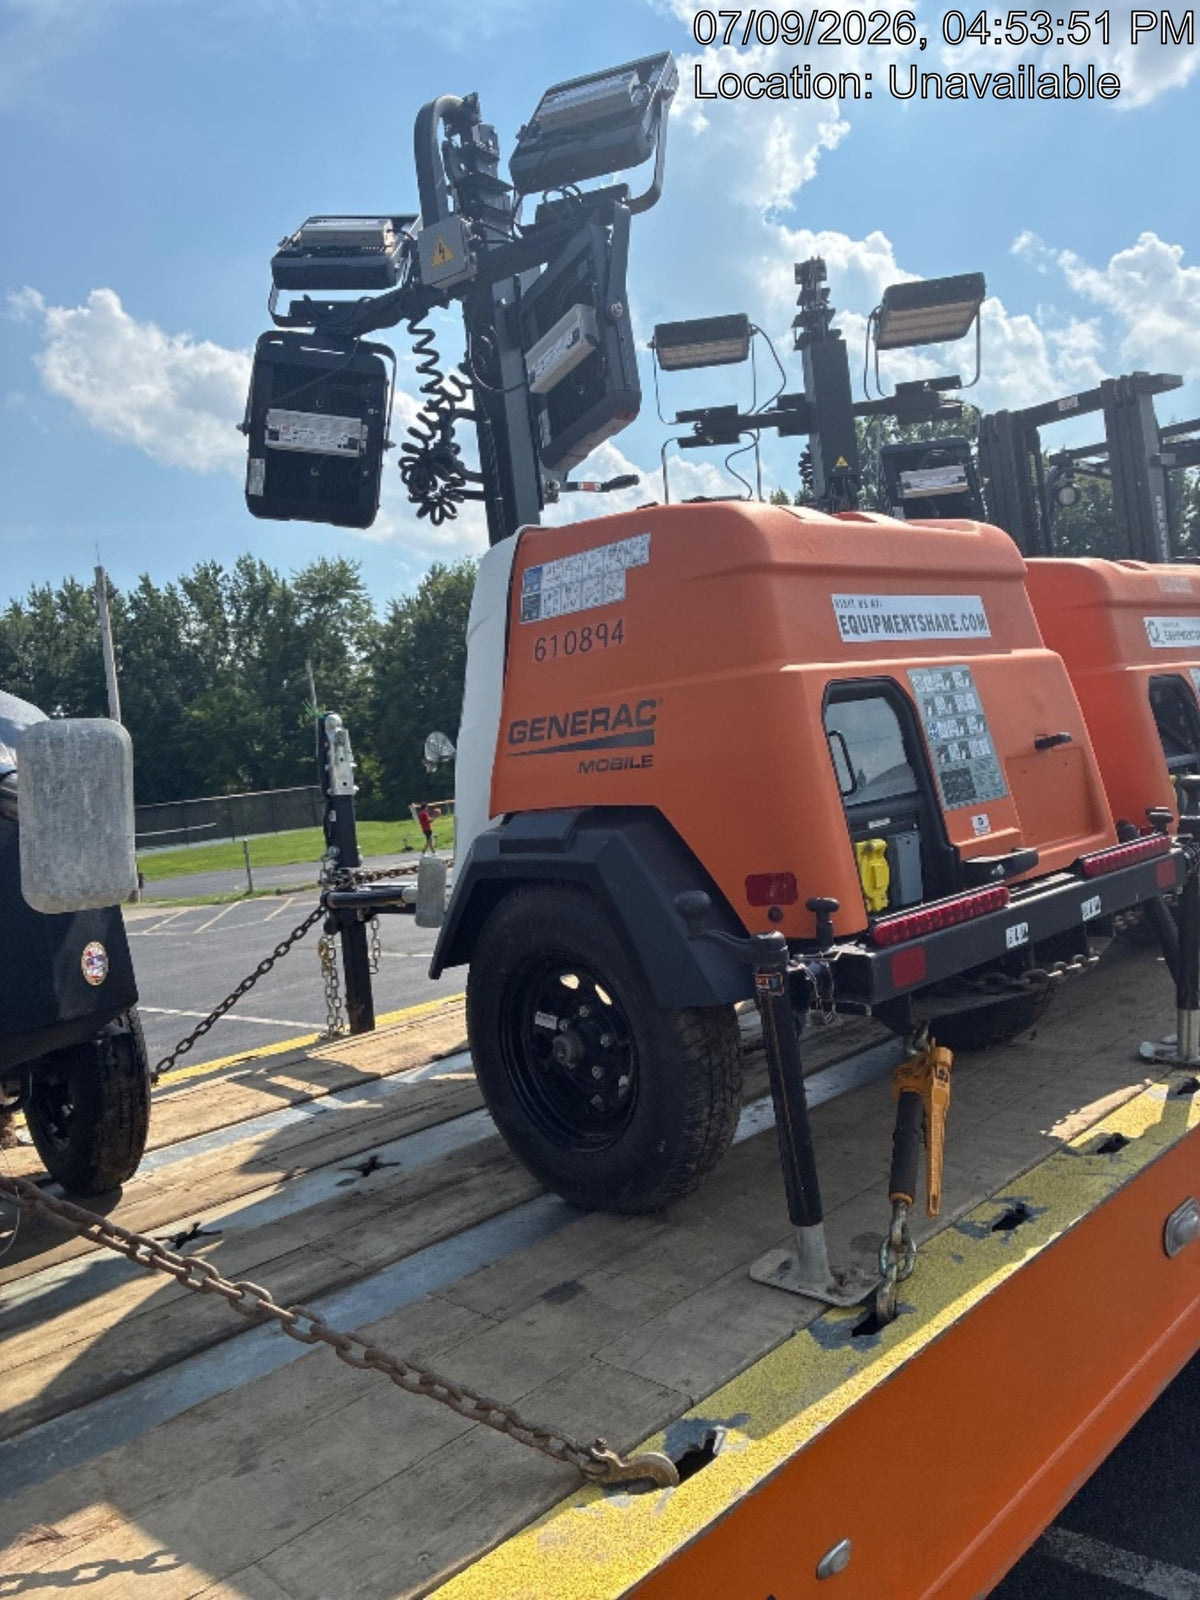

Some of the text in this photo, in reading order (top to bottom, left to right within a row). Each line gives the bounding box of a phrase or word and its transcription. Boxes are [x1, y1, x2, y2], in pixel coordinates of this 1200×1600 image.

[534, 618, 625, 663] 610894
[838, 613, 987, 635] EQUIPMENTSHARE.COM
[507, 699, 657, 746] GENERAC
[578, 754, 655, 775] MOBILE
